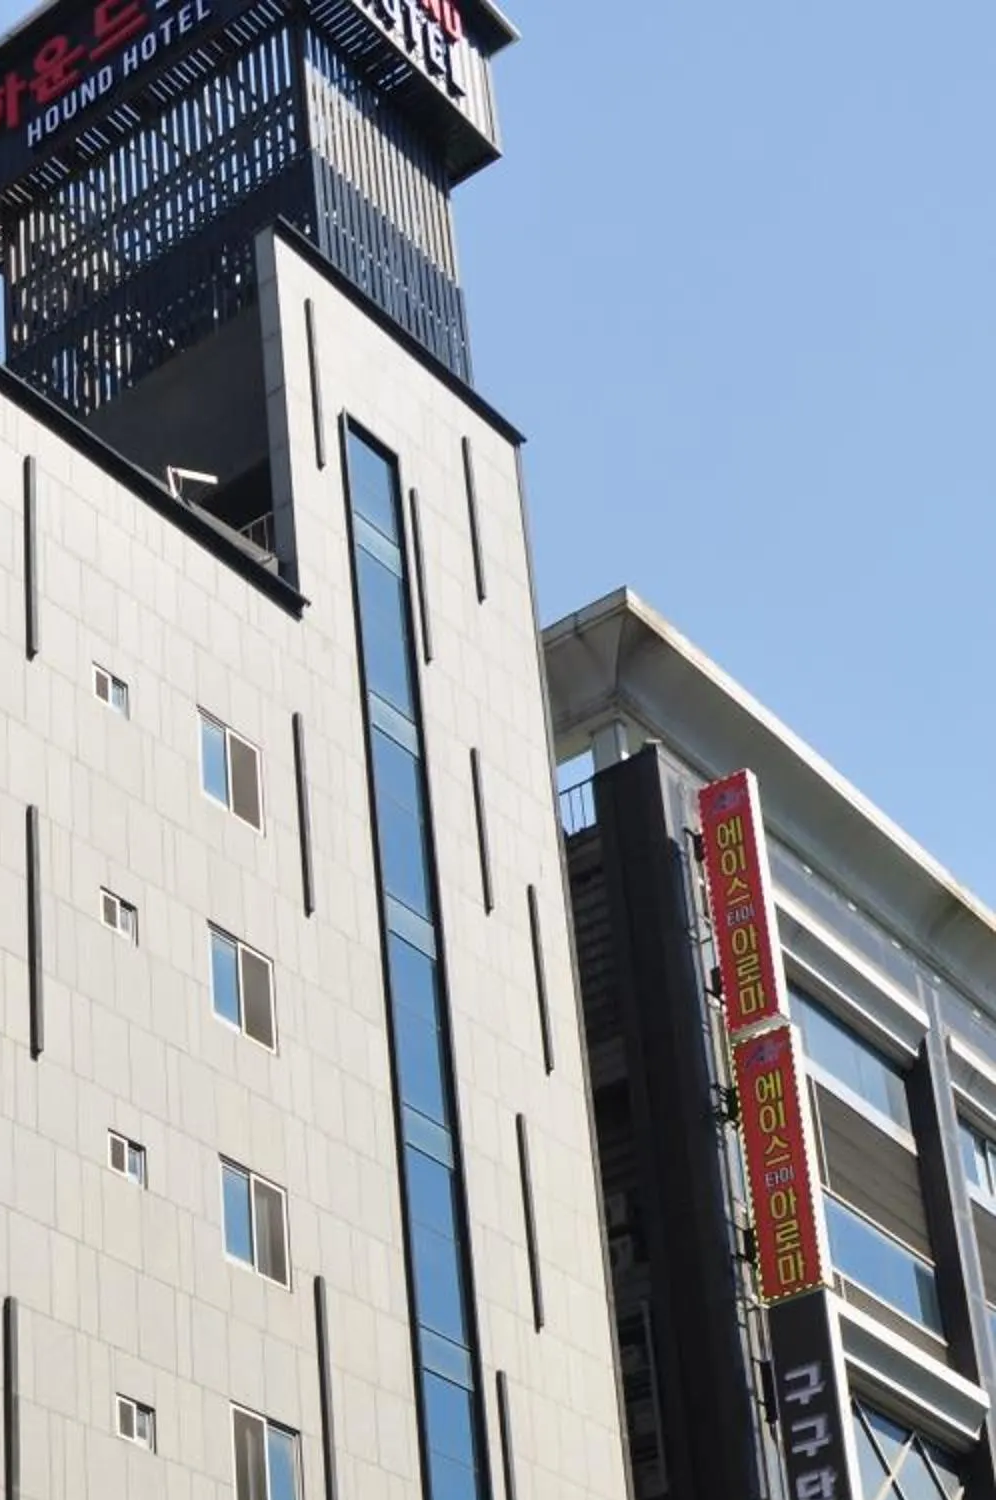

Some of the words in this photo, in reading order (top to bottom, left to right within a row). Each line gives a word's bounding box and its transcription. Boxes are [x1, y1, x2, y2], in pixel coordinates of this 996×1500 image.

[26, 66, 114, 148] HOUND
[122, 0, 211, 77] HOTEL
[717, 816, 752, 905] 에이스
[732, 928, 766, 1015] 아로마
[755, 1072, 792, 1166] 에이스
[770, 1191, 805, 1285] 아로마
